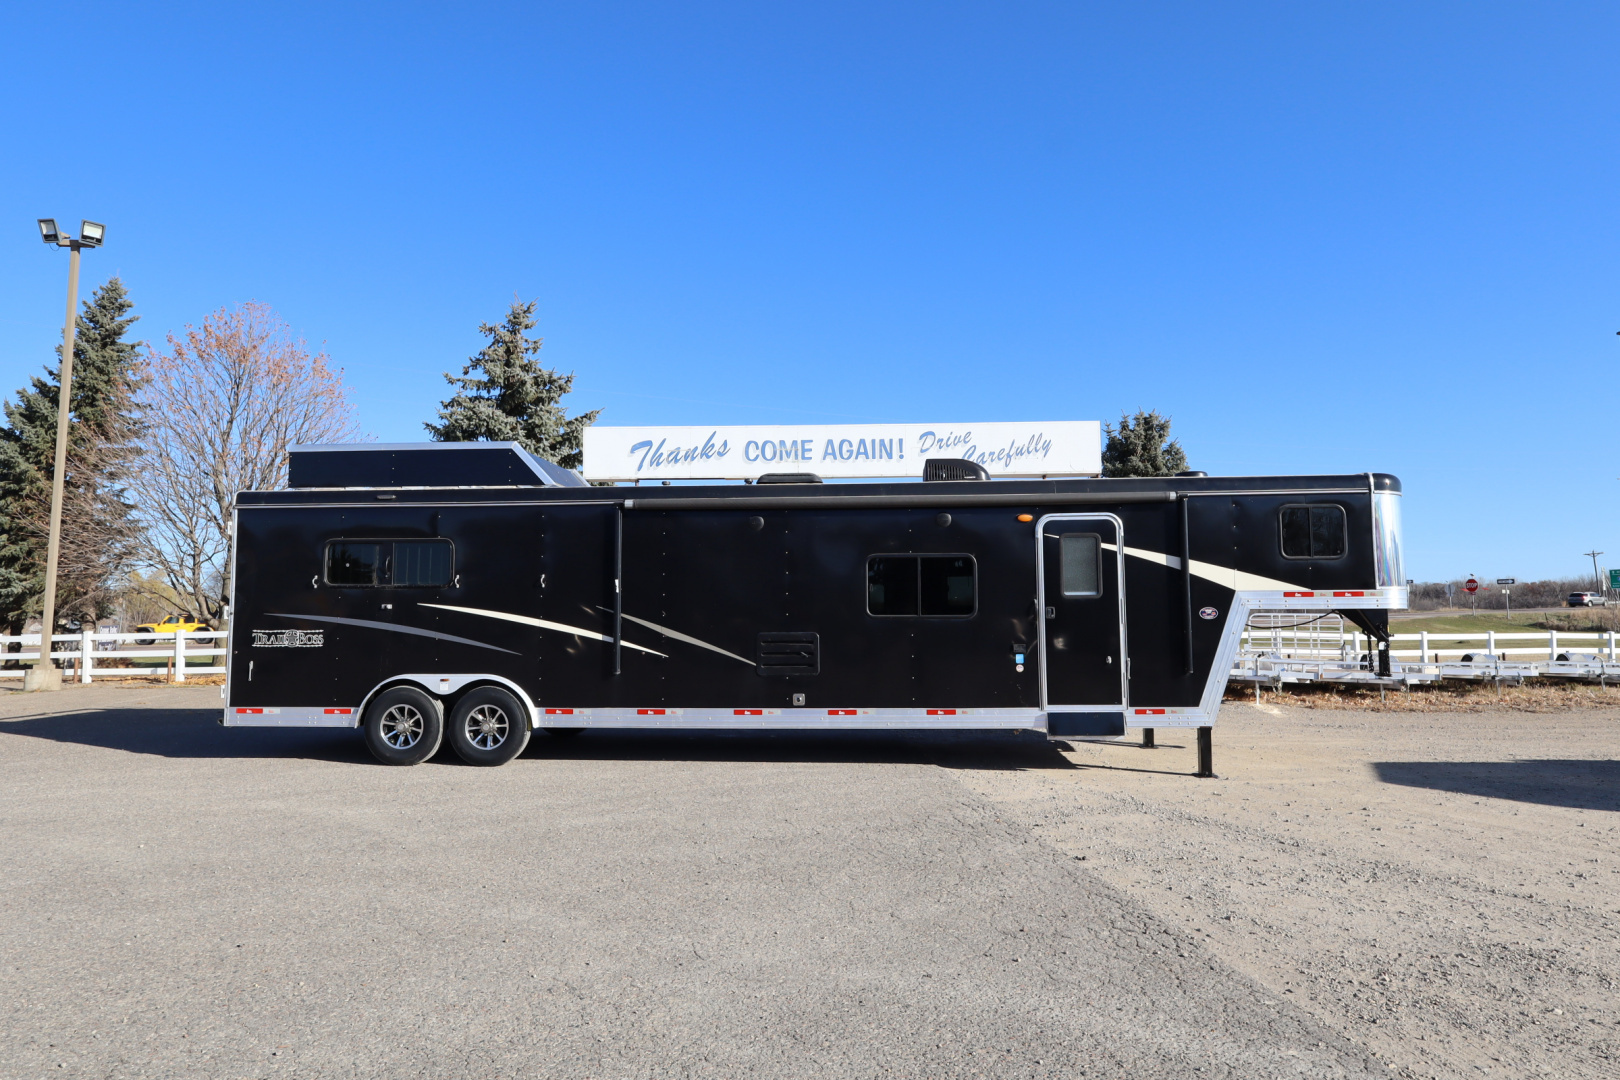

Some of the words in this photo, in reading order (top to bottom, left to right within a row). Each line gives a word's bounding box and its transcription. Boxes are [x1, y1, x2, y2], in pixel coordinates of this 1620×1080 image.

[630, 430, 731, 472] Thanks
[744, 439, 813, 462] COME
[822, 438, 904, 461] AGAIN!
[918, 431, 972, 454] Drive
[961, 432, 1052, 468] Carefully
[298, 632, 325, 645] BOSS
